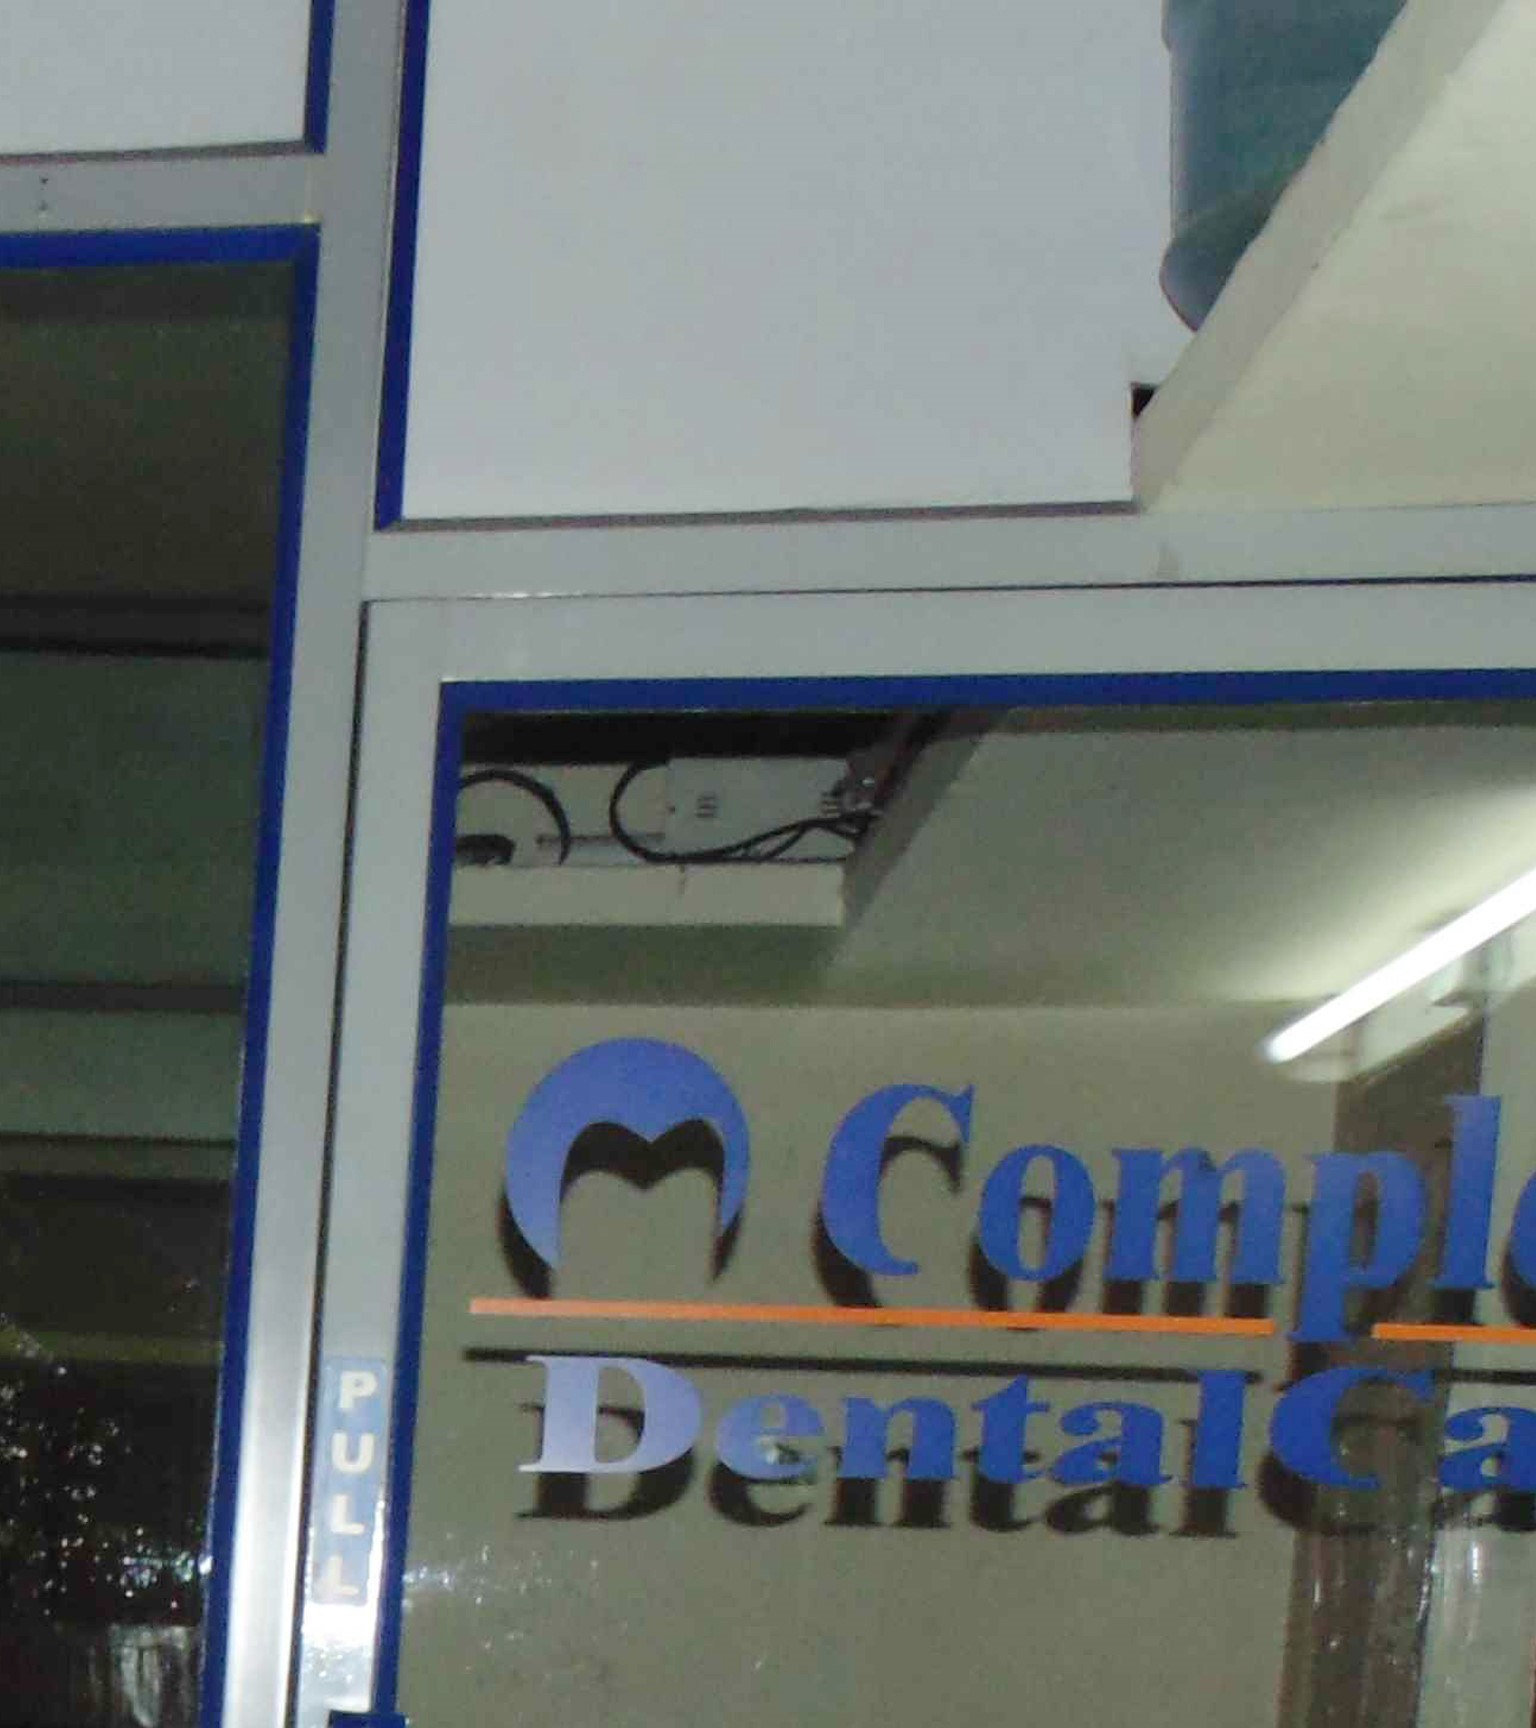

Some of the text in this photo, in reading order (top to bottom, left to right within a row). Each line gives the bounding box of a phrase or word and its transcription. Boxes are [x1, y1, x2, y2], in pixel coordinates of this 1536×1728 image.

[818, 1080, 1536, 1344] Compl
[322, 1369, 378, 1597] PULL
[516, 1352, 1251, 1492] Dental
